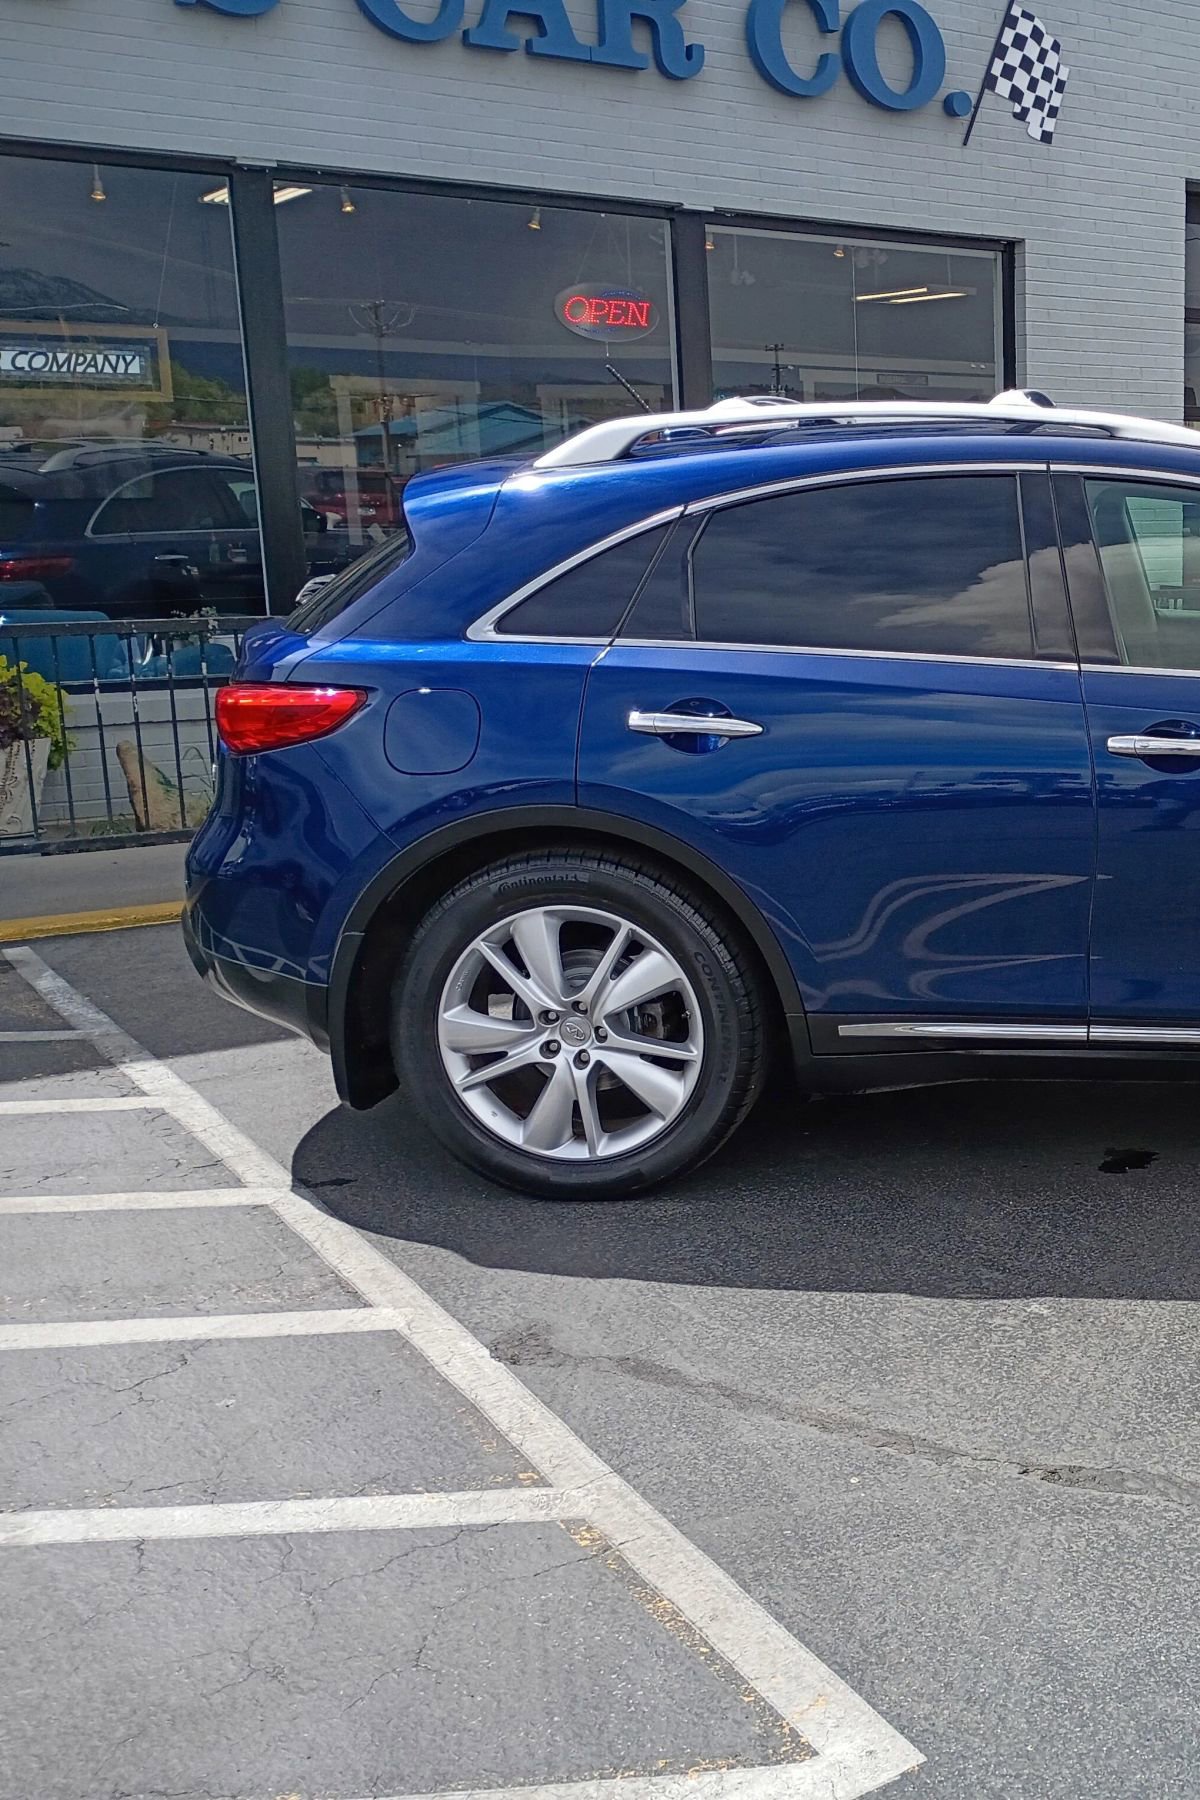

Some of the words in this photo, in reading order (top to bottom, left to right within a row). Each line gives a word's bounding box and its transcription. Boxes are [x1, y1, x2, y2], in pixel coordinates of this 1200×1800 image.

[746, 0, 972, 117] CO.
[563, 295, 650, 327] OPEN
[10, 351, 136, 374] COMPANY
